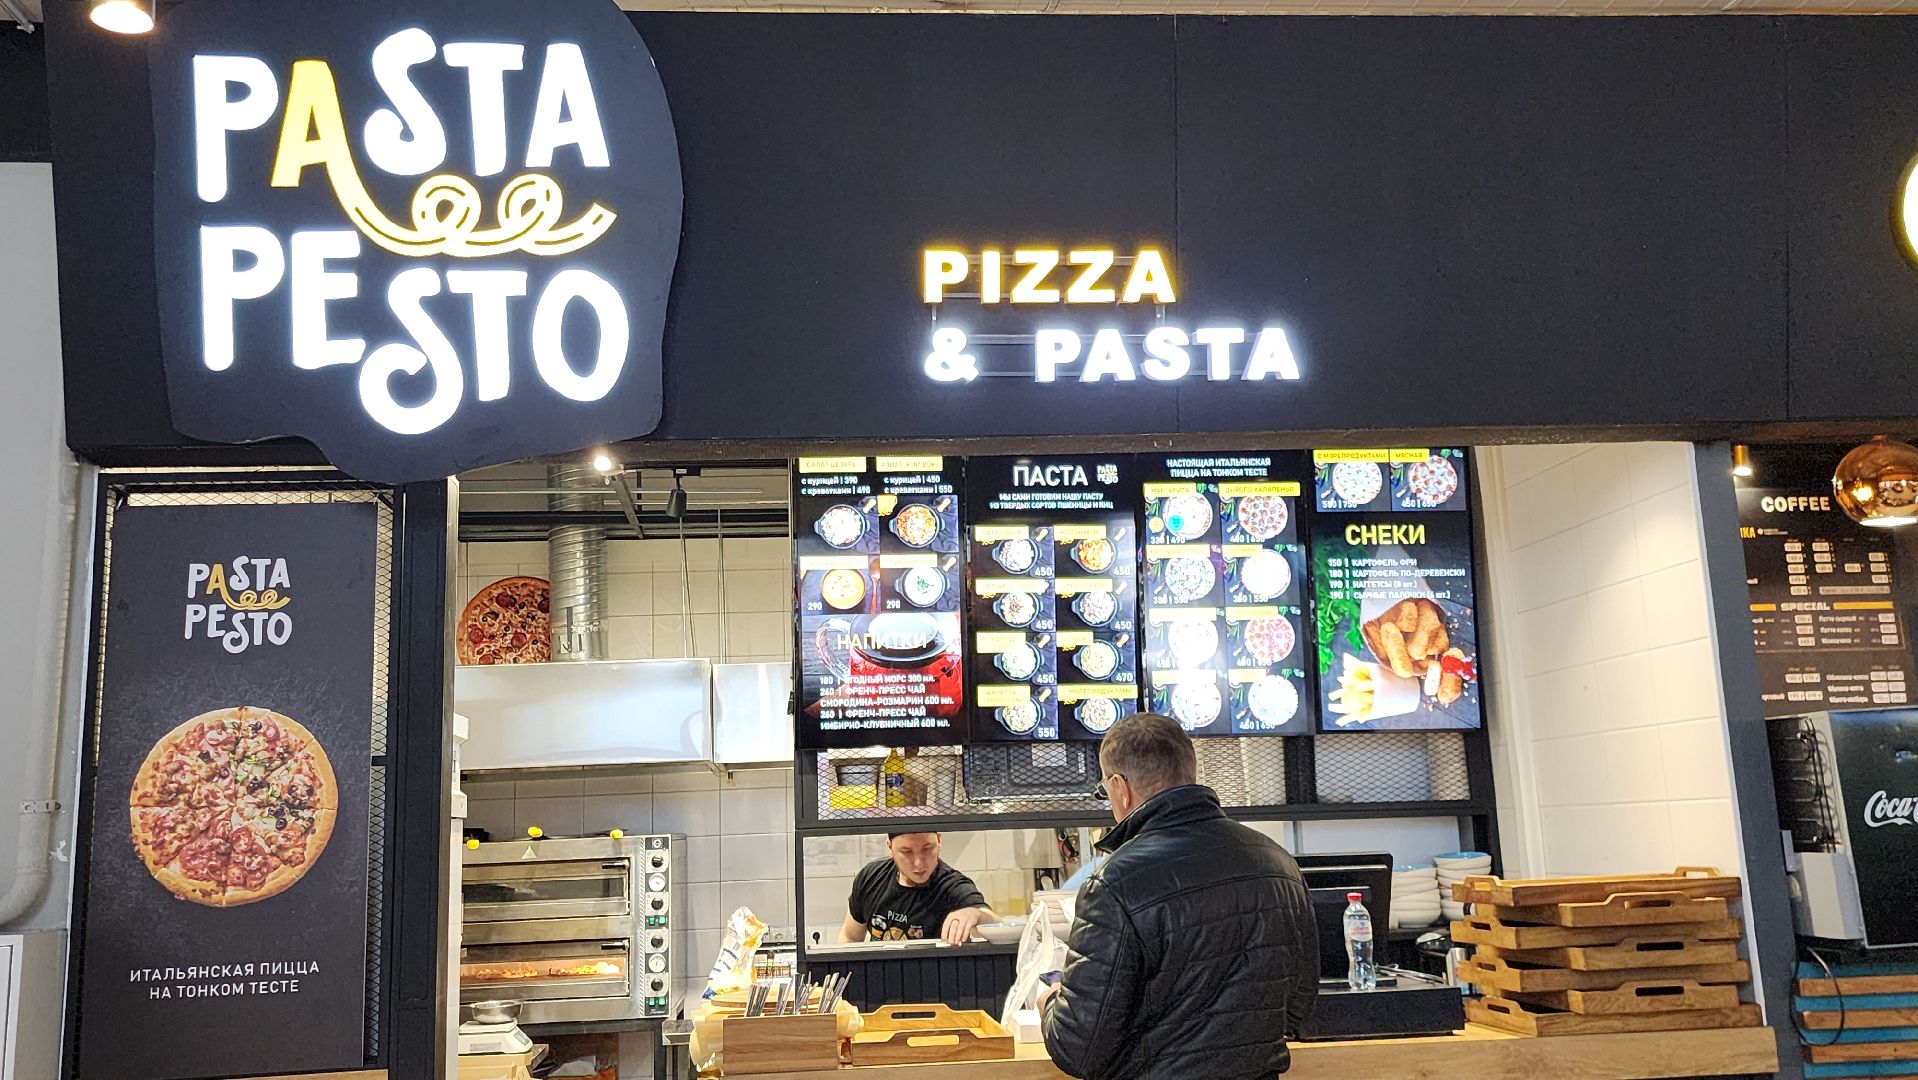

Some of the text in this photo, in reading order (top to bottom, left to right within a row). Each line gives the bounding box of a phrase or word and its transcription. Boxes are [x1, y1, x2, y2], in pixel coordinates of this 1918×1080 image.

[192, 28, 611, 204] PASTA
[923, 249, 1177, 304] PIZZA
[200, 225, 630, 435] PESTO
[923, 326, 1301, 384] & PASTA
[1166, 457, 1271, 468] НАСТОЯЩАЯ ИТАЛЬЯНСКАЯ
[1013, 464, 1089, 487] ПАСТА
[1170, 467, 1269, 479] ПИЦЦА НА ТОНКОМ ТЕСТЕ
[807, 475, 840, 486] курицей
[844, 475, 858, 485] 390
[890, 474, 922, 486] курицей
[926, 474, 941, 484] 450
[807, 487, 852, 496] креветками
[890, 486, 934, 496] креветками
[998, 492, 1104, 501] МЫ САМИ ГОТОВИМ НАШУ ПАСТУ
[1000, 501, 1031, 510] ТВЕРДЫХ
[1030, 501, 1057, 510] СОРТОВ
[1057, 501, 1092, 511] ПШЕНИЦЫ
[1760, 496, 1831, 513] COFFEE
[1344, 523, 1427, 546] СНЕКИ
[1350, 558, 1399, 567] КАРТОФЕЛЬ
[1398, 558, 1418, 567] ФРИ
[1035, 566, 1053, 576] 450
[1113, 566, 1131, 576] 450
[1351, 569, 1400, 578] КАРТОФЕЛЬ
[1400, 568, 1466, 578] ПО-ДЕРЕВЕНСКИ
[187, 556, 291, 599] PASTA
[1352, 580, 1393, 589] НАГГЕТСЫ
[1353, 591, 1387, 600] СЫРНЫЕ
[1388, 591, 1426, 600] ПАЛОЧКИ
[807, 602, 823, 611] 290
[886, 600, 901, 610] 290
[1780, 602, 1831, 612] SPECIAL
[184, 604, 293, 654] PESTO
[1036, 619, 1053, 630] 450
[1114, 619, 1132, 629] 450
[836, 632, 928, 651] НАПИТКИ
[883, 675, 906, 684] МОРС
[1036, 674, 1055, 684] 450
[1115, 672, 1133, 682] 470
[819, 683, 926, 697] 260 ФРЕНЧ-ПРЕСС ЧАЙ
[820, 697, 924, 708] СМОРОДИНА-РОЗМАРИН
[924, 696, 939, 706] 600
[820, 706, 926, 719] 260 ФРЕНЧ-ПРЕСС ЧАЙ
[820, 717, 920, 730] ИМБИРНО-КЛУБНИЧНЫЙ
[921, 718, 936, 728] 600
[1038, 727, 1055, 738] 550
[887, 910, 909, 924] PIZZA
[129, 960, 321, 983] ИТАЛЬЯНСКАЯ ПИЦЦА
[149, 979, 300, 1000] НА ТОНКОМ ТЕСТЕ
